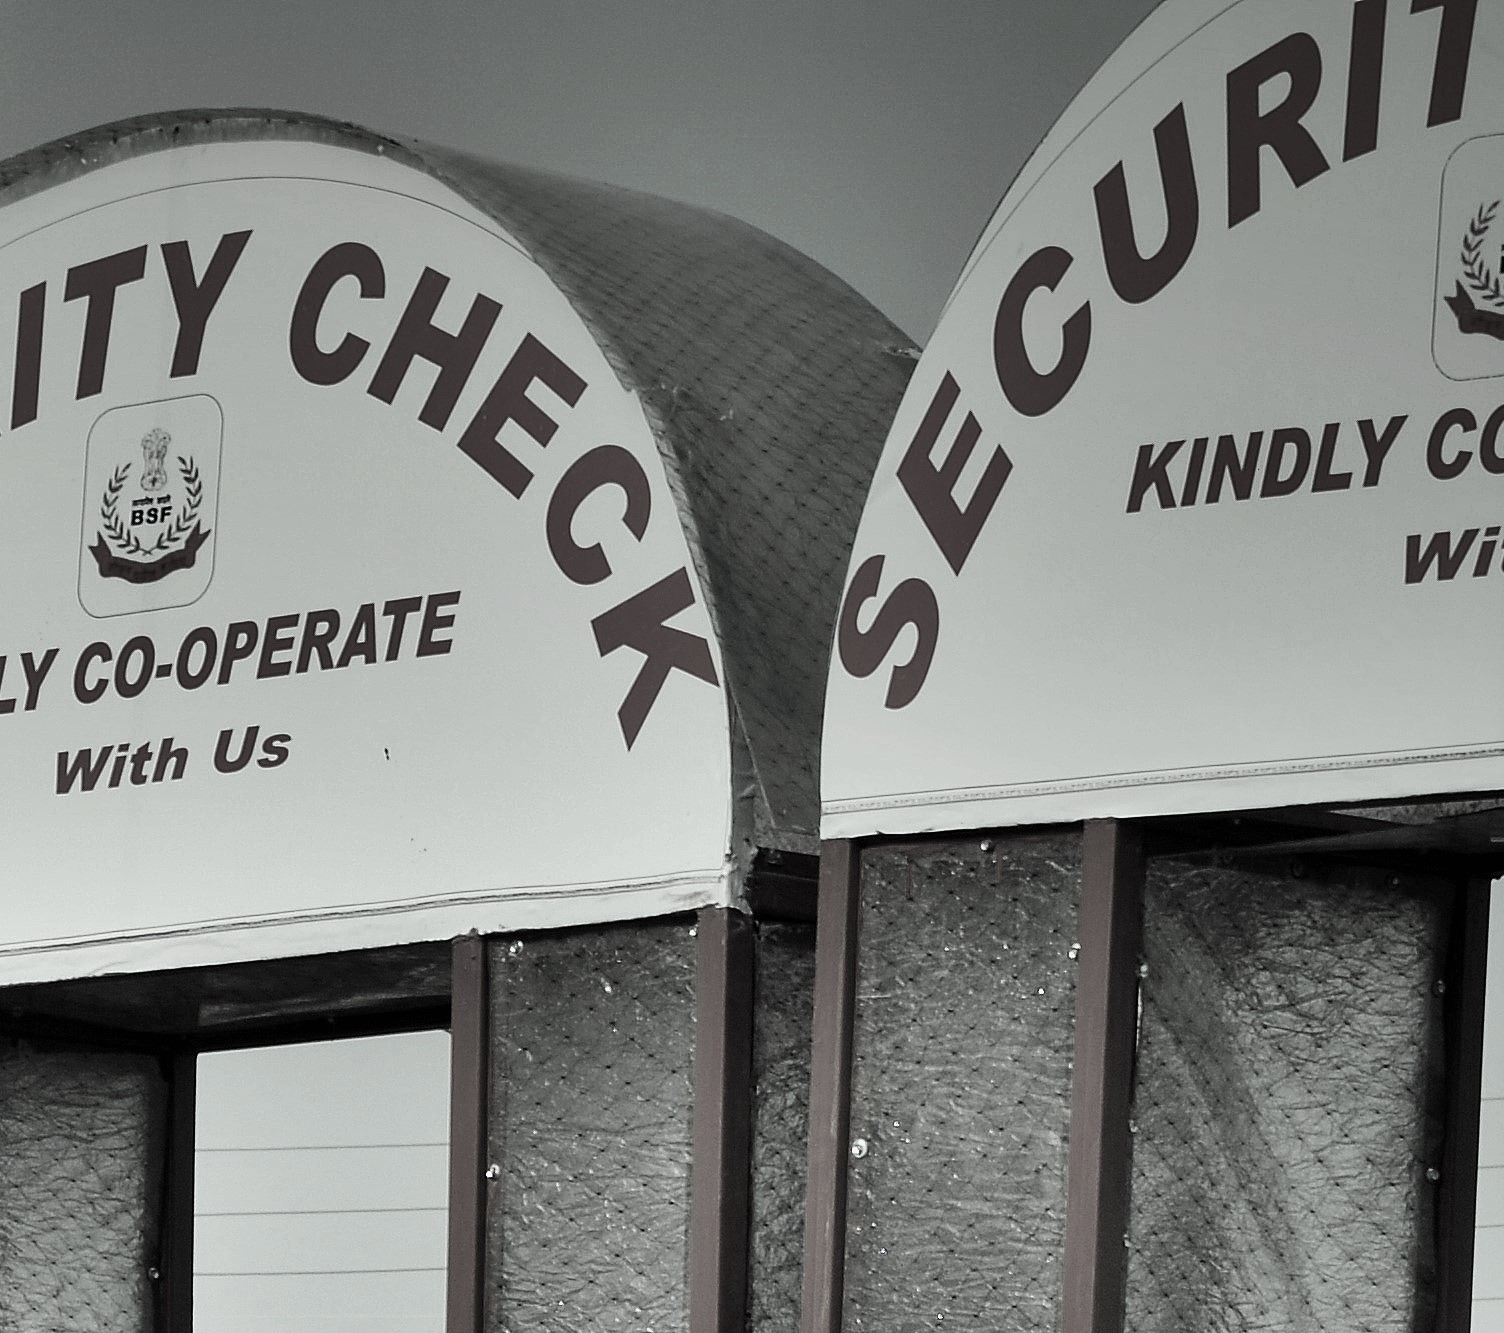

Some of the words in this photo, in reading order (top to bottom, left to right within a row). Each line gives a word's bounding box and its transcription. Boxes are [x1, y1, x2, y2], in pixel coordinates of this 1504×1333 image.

[290, 242, 720, 751] CHECK
[1126, 414, 1409, 514] KINDLY
[131, 505, 172, 526] BSF
[73, 590, 461, 704] CO-OPERATE
[56, 737, 189, 795] With
[213, 725, 292, 774] Us
